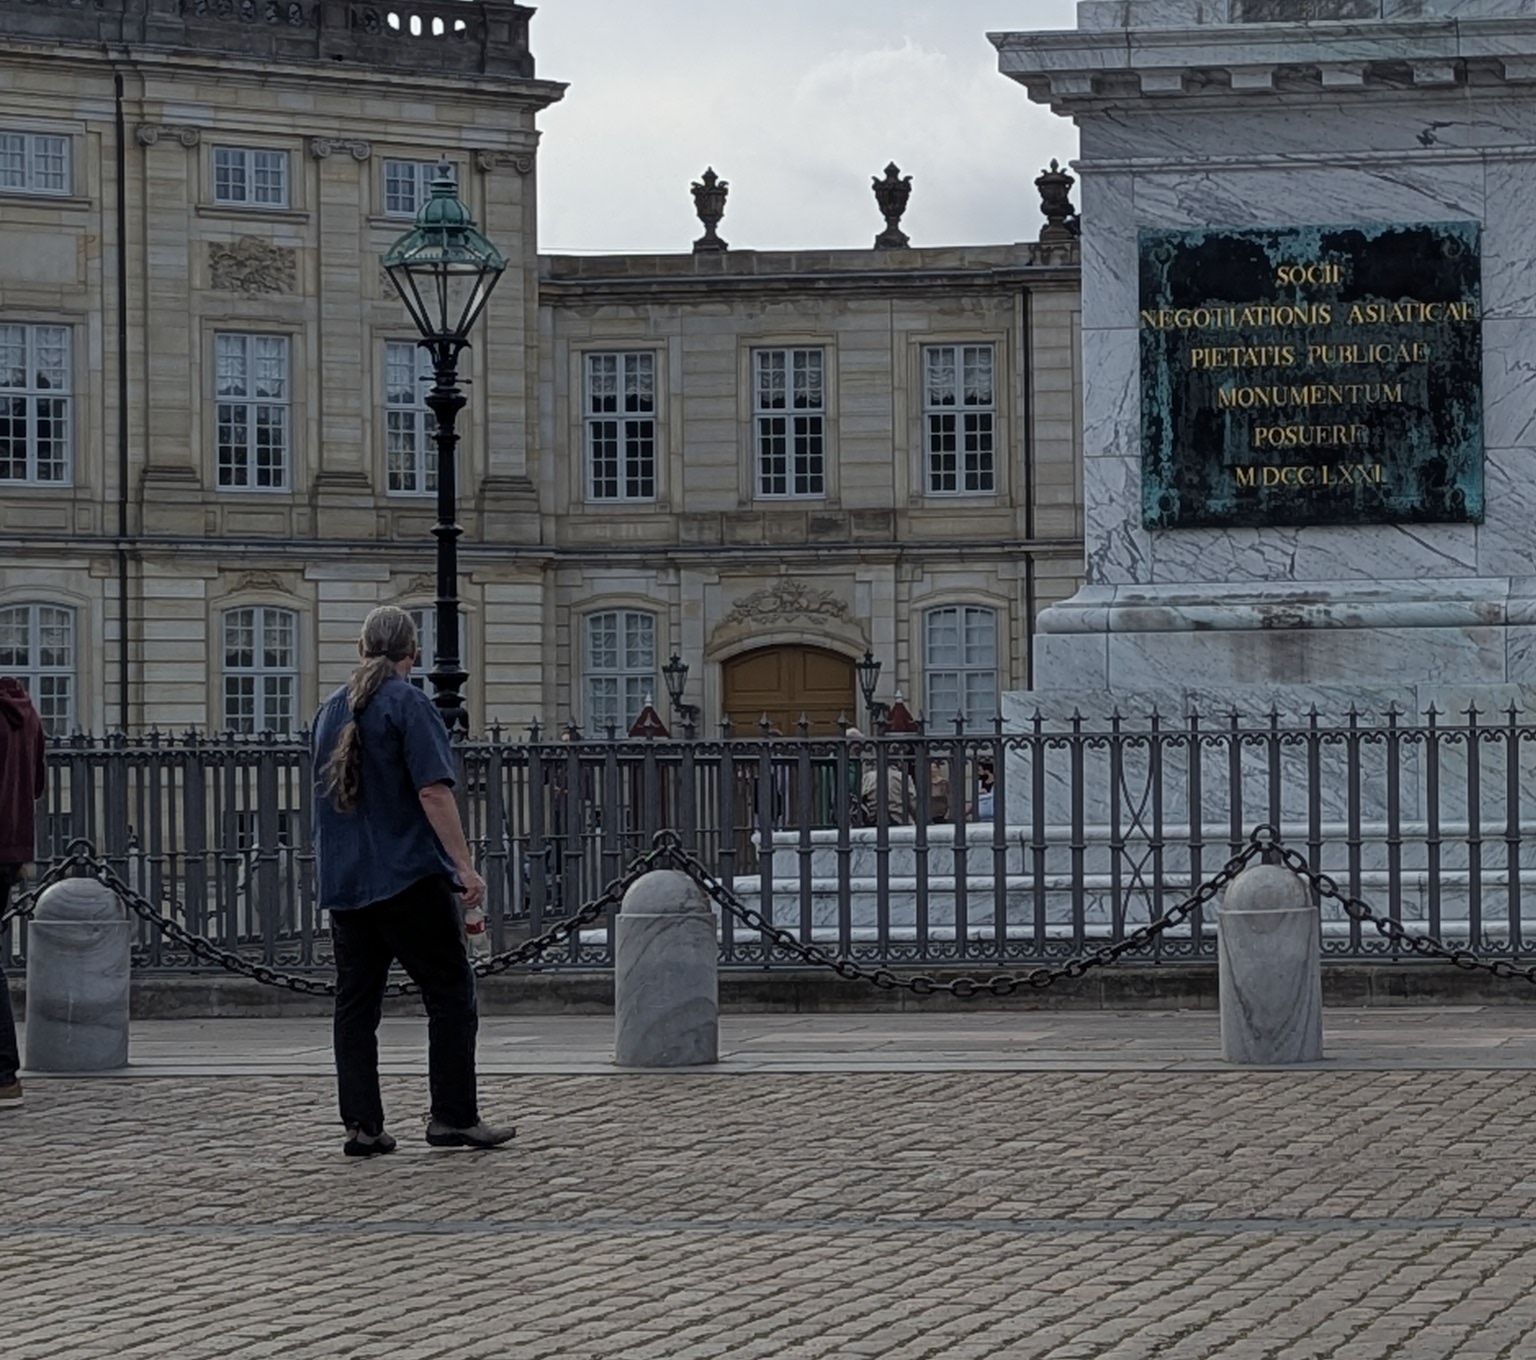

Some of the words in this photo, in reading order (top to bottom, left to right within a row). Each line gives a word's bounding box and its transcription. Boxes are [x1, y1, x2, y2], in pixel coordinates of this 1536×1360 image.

[1141, 304, 1332, 329] NEGOTIATIONIS
[1349, 301, 1480, 325] ASIATICAE
[1191, 346, 1296, 368] PIETATIS
[1308, 343, 1429, 364] PUBLICAE
[1217, 383, 1403, 408] MONUMENTUM
[1253, 424, 1369, 447] POSUERE
